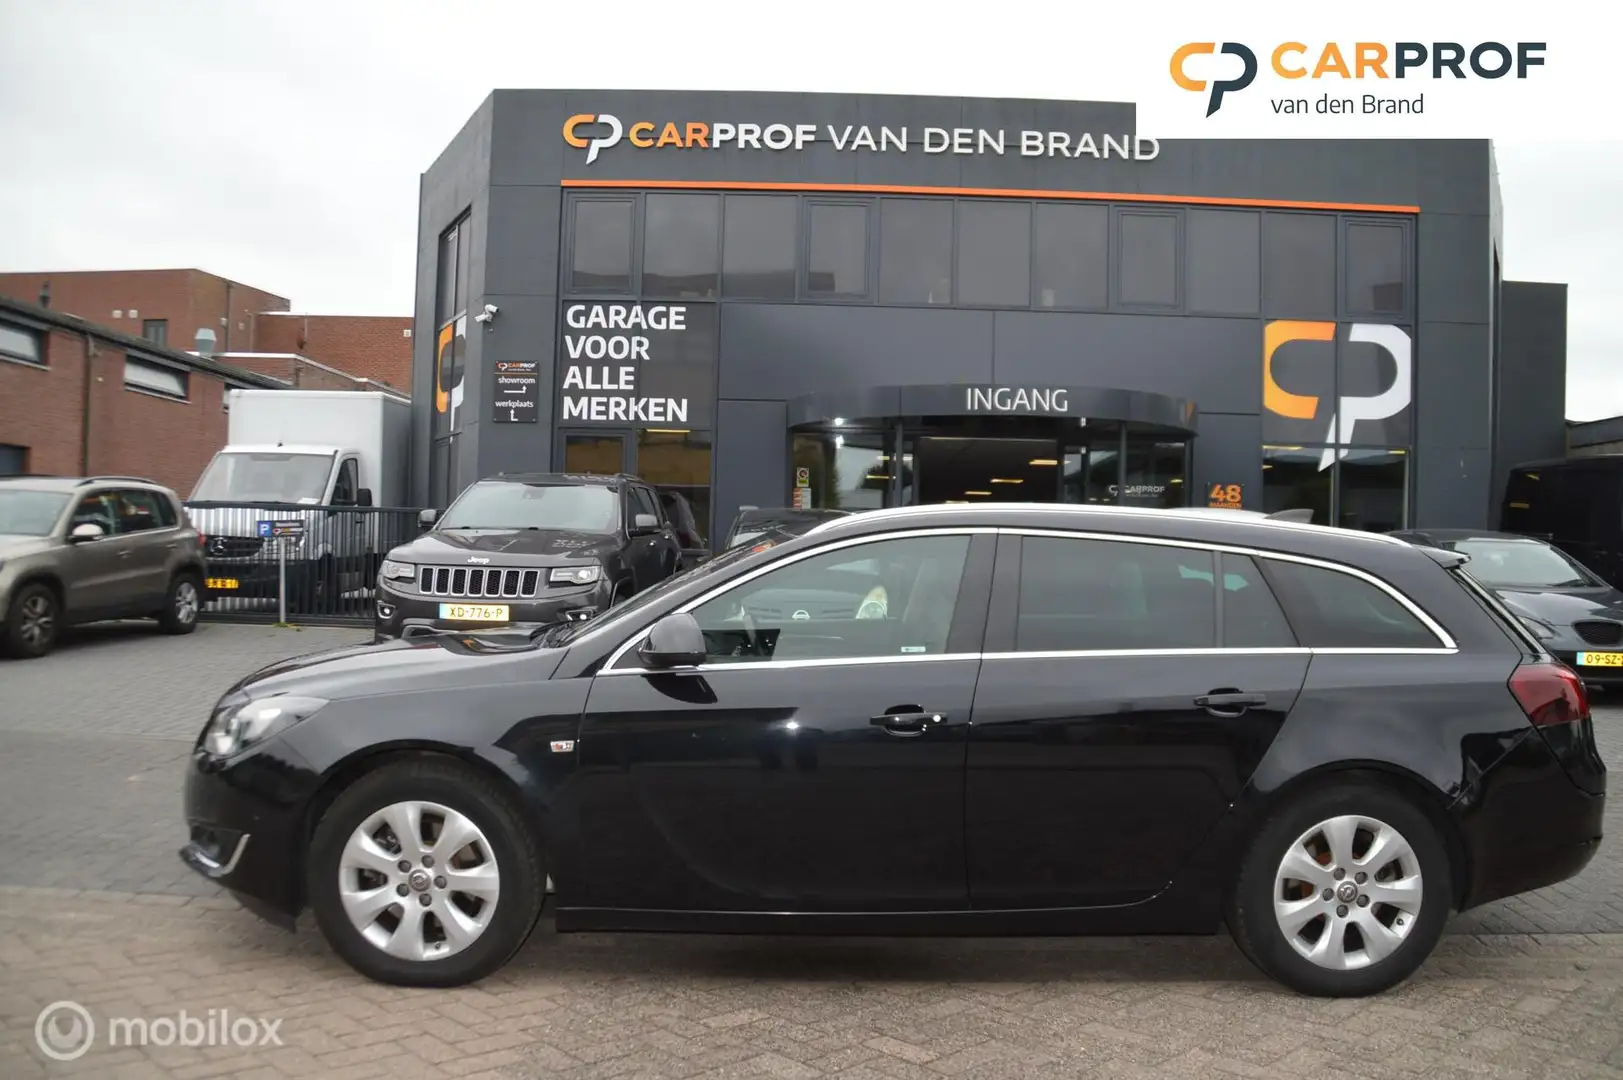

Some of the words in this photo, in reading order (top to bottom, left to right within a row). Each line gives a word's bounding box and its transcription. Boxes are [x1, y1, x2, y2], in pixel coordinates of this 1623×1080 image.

[628, 121, 817, 150] CARPROF
[827, 125, 908, 152] VAN
[923, 127, 1005, 155] DEN
[1020, 130, 1160, 161] BRAND
[566, 304, 687, 330] GARAGE
[565, 335, 650, 360] VOOR
[498, 376, 536, 384] showroom
[563, 366, 635, 390] ALLE
[495, 400, 534, 408] werkplaats
[562, 396, 688, 422] MERKEN
[966, 387, 1068, 412] INGANG
[1210, 484, 1242, 503] 48
[467, 556, 490, 564] Jeep
[450, 607, 502, 618] XD-776-P
[1586, 654, 1623, 664] 09-SZ-
